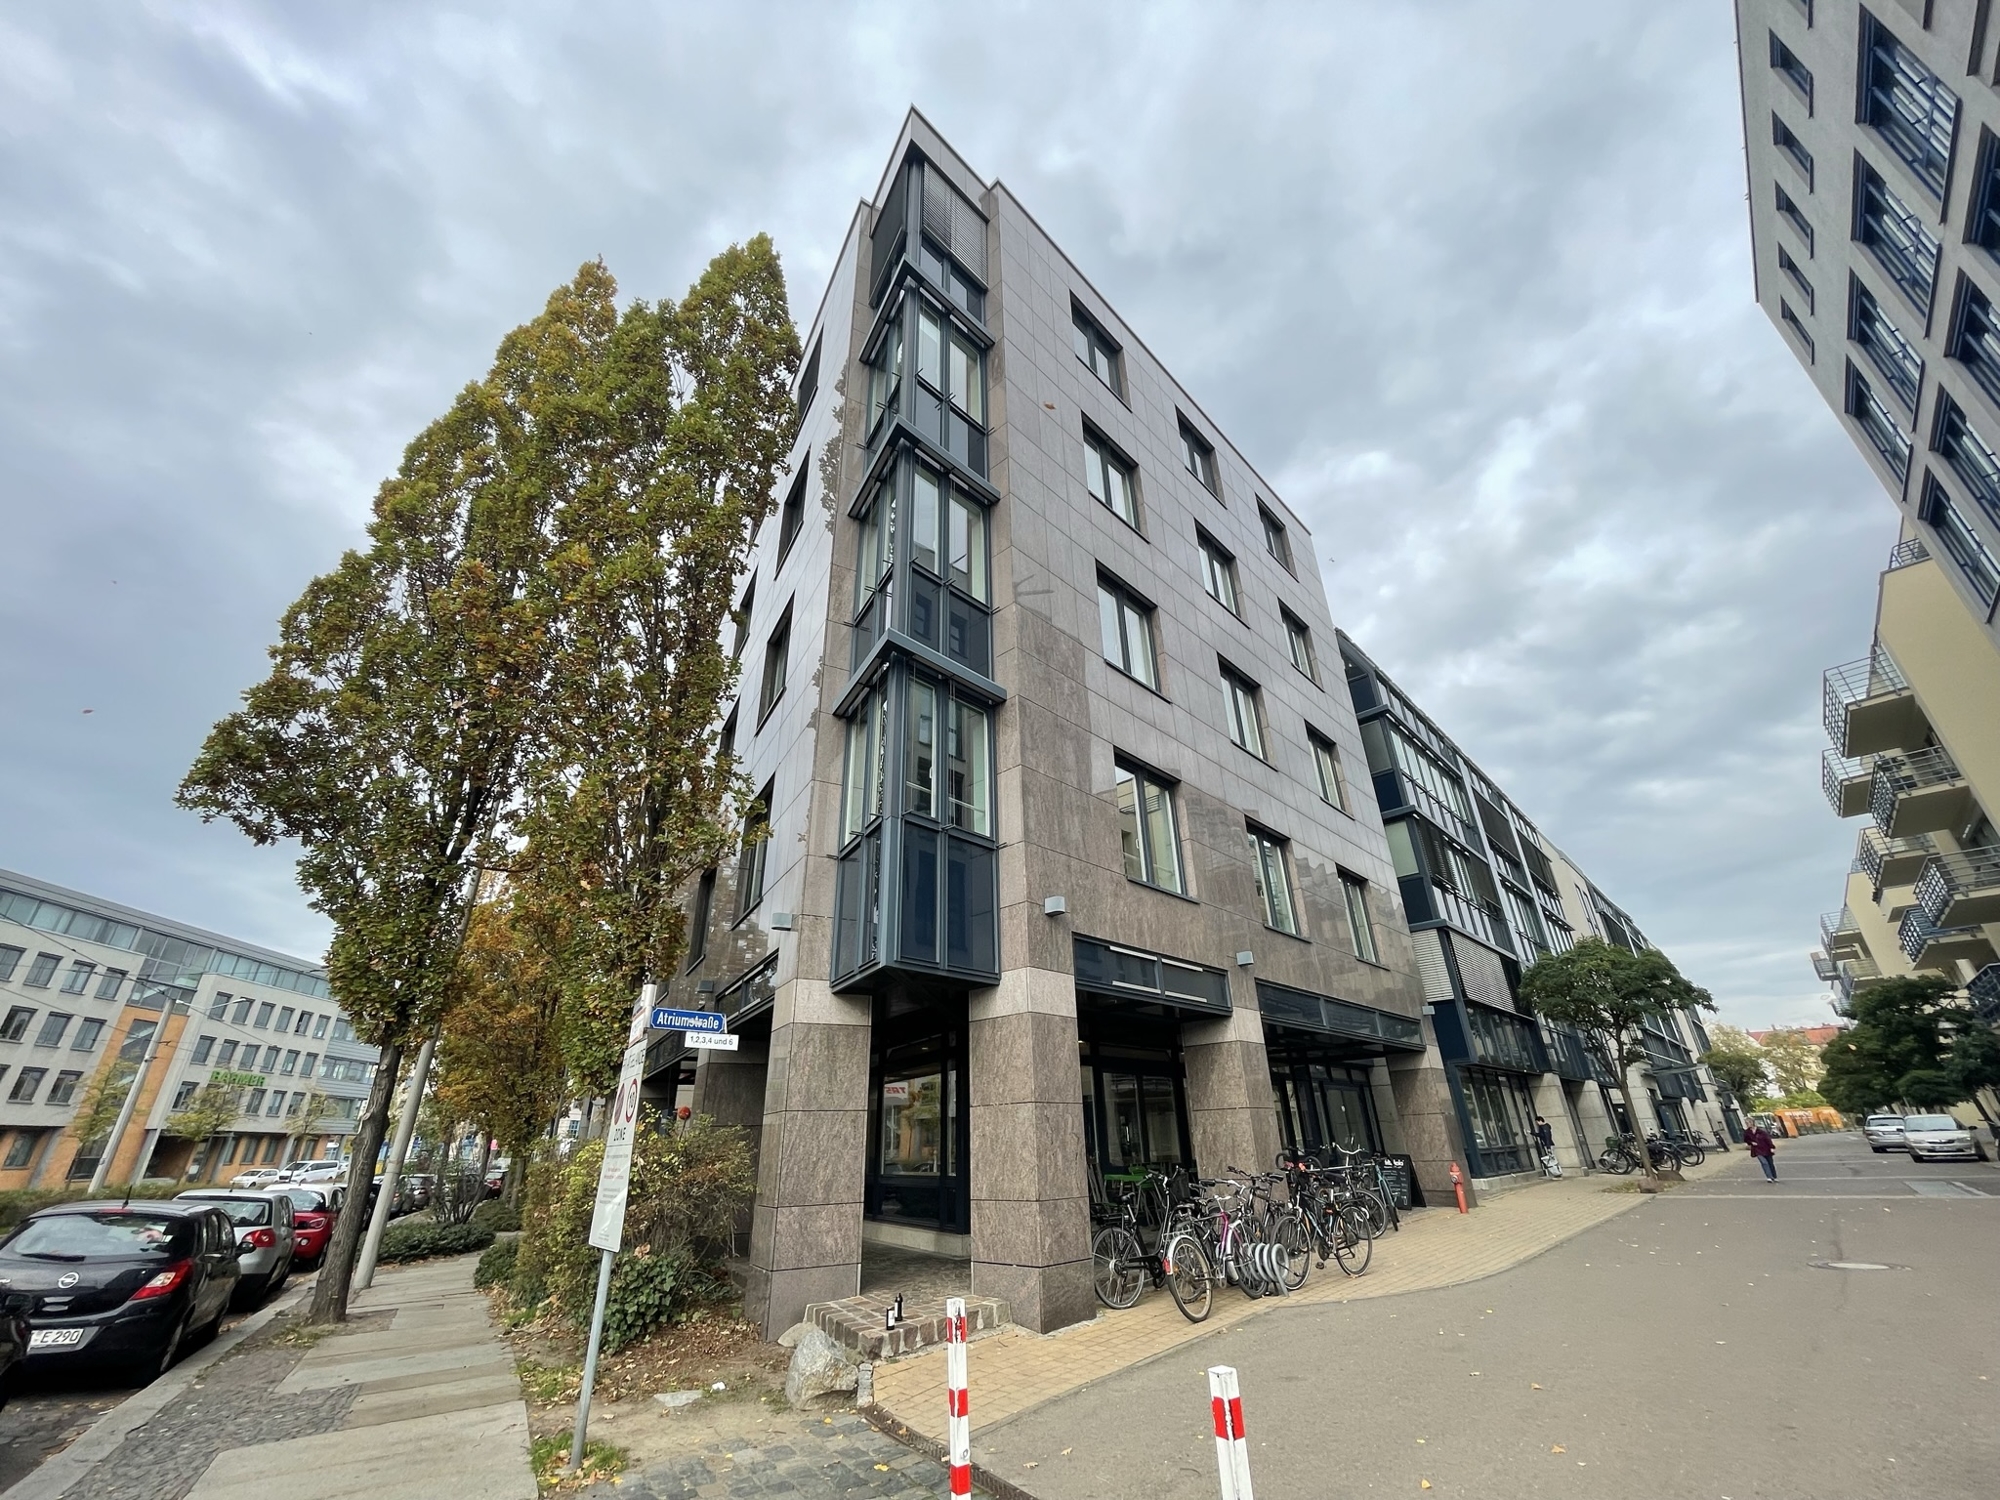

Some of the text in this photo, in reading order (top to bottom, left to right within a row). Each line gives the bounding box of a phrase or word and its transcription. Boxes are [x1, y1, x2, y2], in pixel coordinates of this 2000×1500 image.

[656, 1011, 720, 1030] Atriumstraße
[690, 1035, 734, 1046] 1,2,3,4 und 6
[210, 1070, 266, 1087] BARMER
